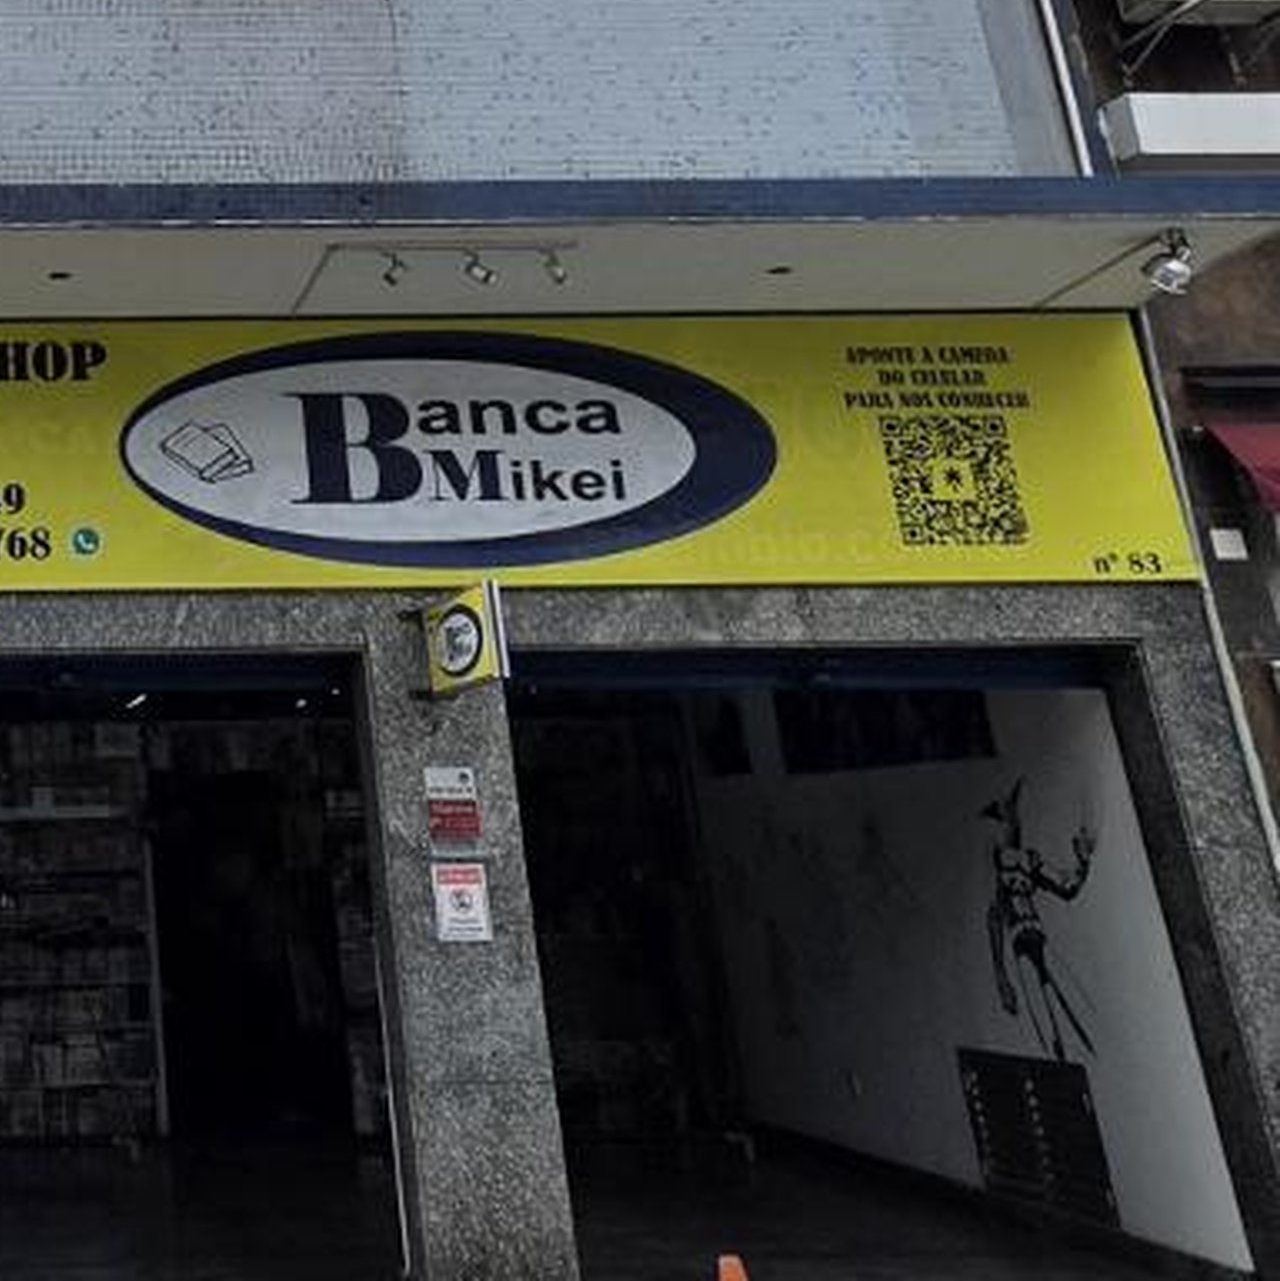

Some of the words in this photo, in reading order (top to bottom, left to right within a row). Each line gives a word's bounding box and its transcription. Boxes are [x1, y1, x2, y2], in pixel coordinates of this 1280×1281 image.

[846, 346, 914, 364] APONTE
[921, 346, 934, 364] A
[878, 370, 904, 385] DO
[911, 369, 986, 386] CELULAR
[844, 392, 894, 409] PARA
[939, 392, 1030, 408] CONHECER
[284, 392, 622, 505] Banca
[428, 449, 626, 502] Mikei
[1127, 552, 1162, 574] 83
